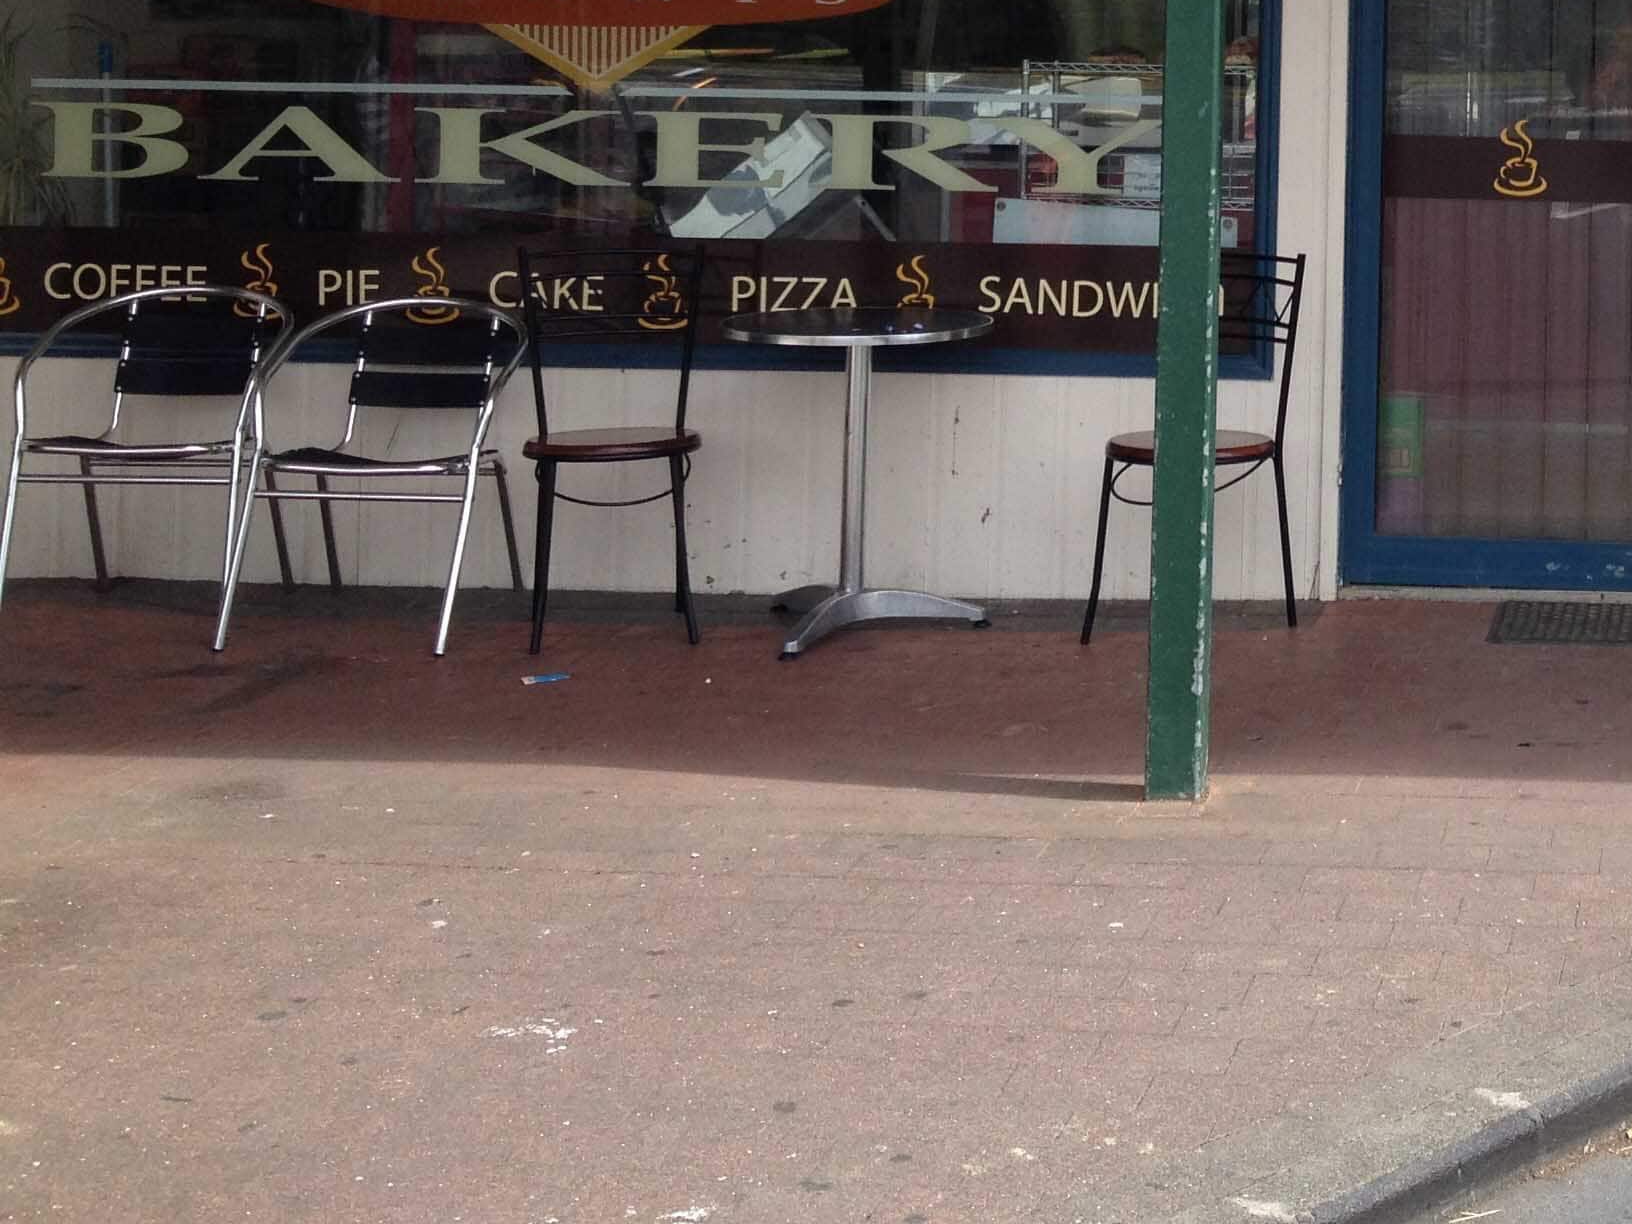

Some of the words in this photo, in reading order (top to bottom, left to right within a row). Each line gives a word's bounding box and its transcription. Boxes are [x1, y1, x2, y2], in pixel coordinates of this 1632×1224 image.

[31, 101, 1162, 195] BAKERY
[43, 262, 208, 302] COFFEE
[318, 269, 380, 306] PIE
[489, 271, 604, 311] CAKE
[731, 275, 857, 313] PIZZA
[978, 275, 1224, 319] SANDWI
